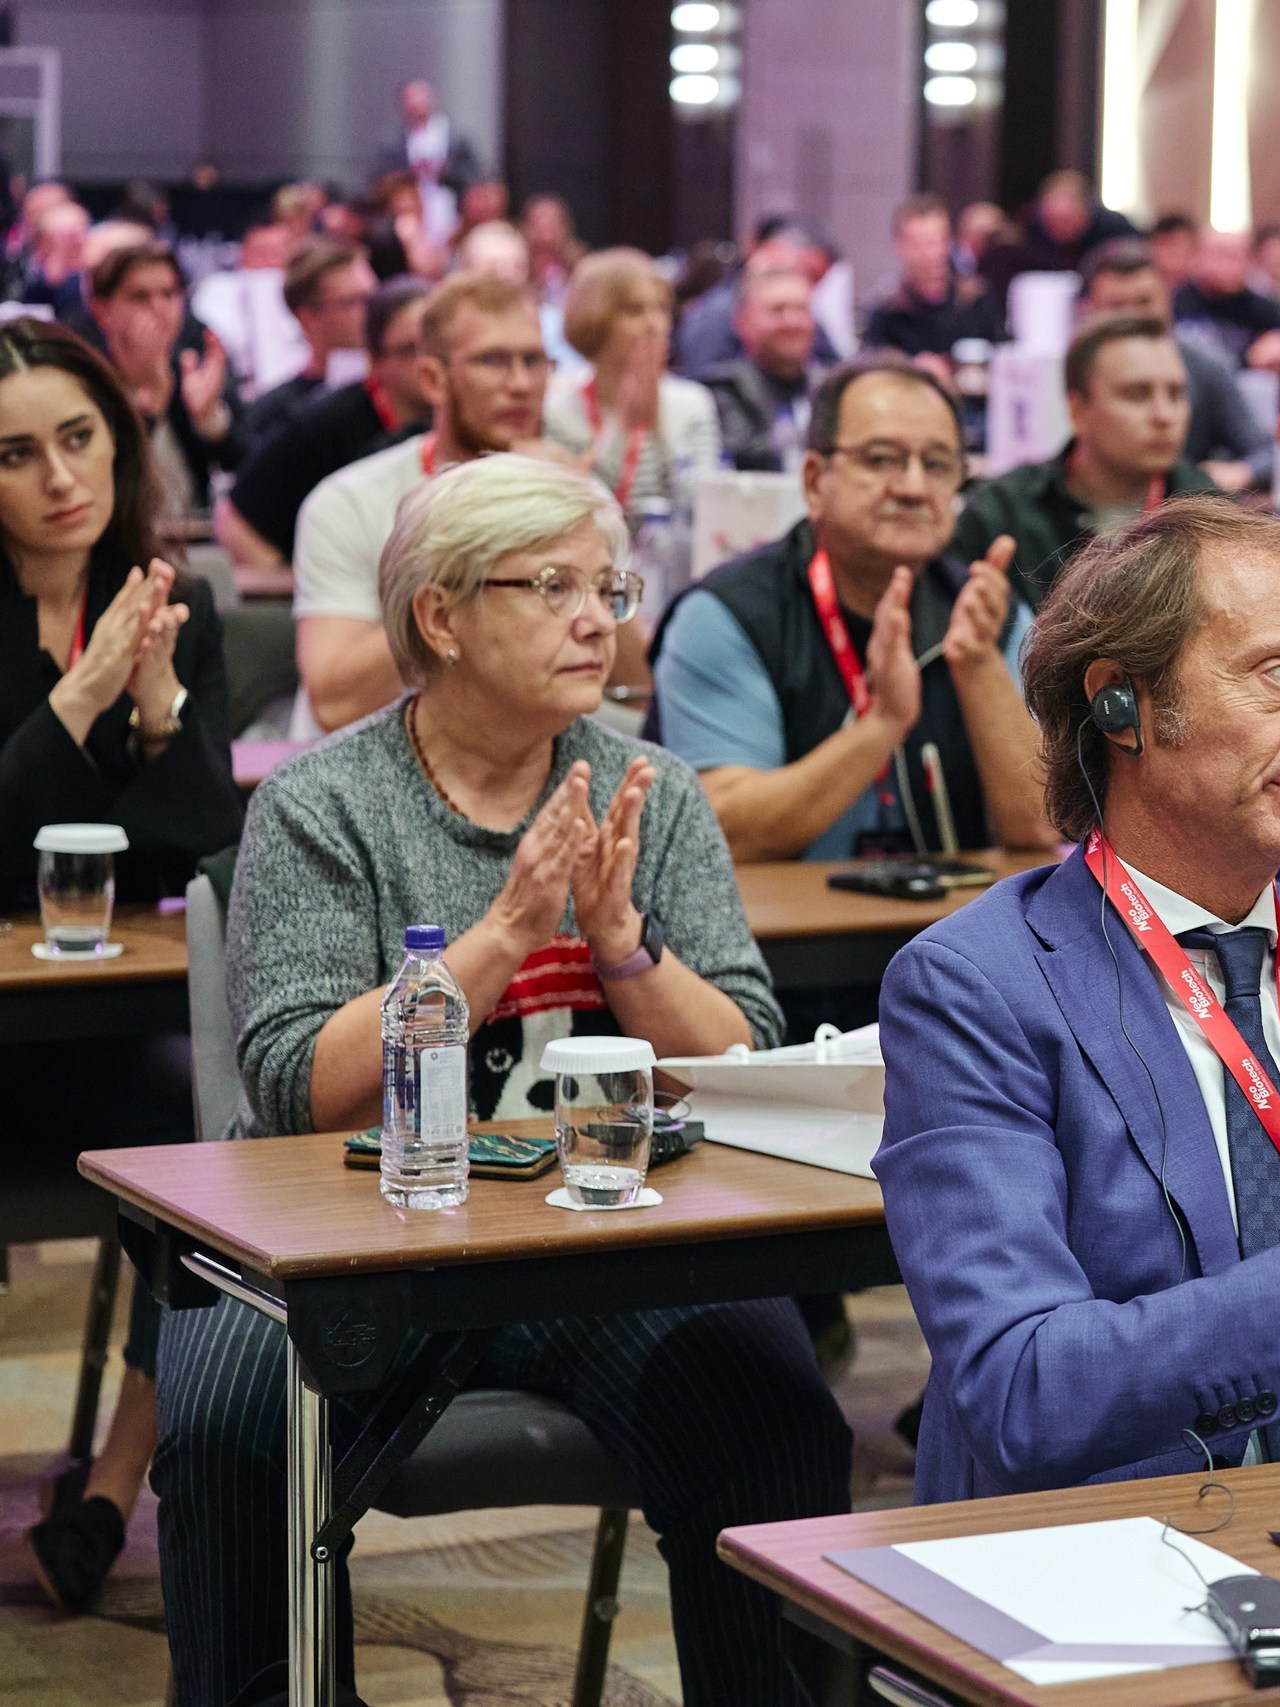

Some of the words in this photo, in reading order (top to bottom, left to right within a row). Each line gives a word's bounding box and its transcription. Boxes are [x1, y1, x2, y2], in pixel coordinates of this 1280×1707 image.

[1121, 882, 1150, 920] Biotech
[1129, 909, 1152, 931] Neo
[1181, 969, 1210, 1008] Biotech
[1189, 996, 1213, 1019] Neo
[1242, 1058, 1268, 1099] Biotech
[1249, 1086, 1272, 1110] Neo
